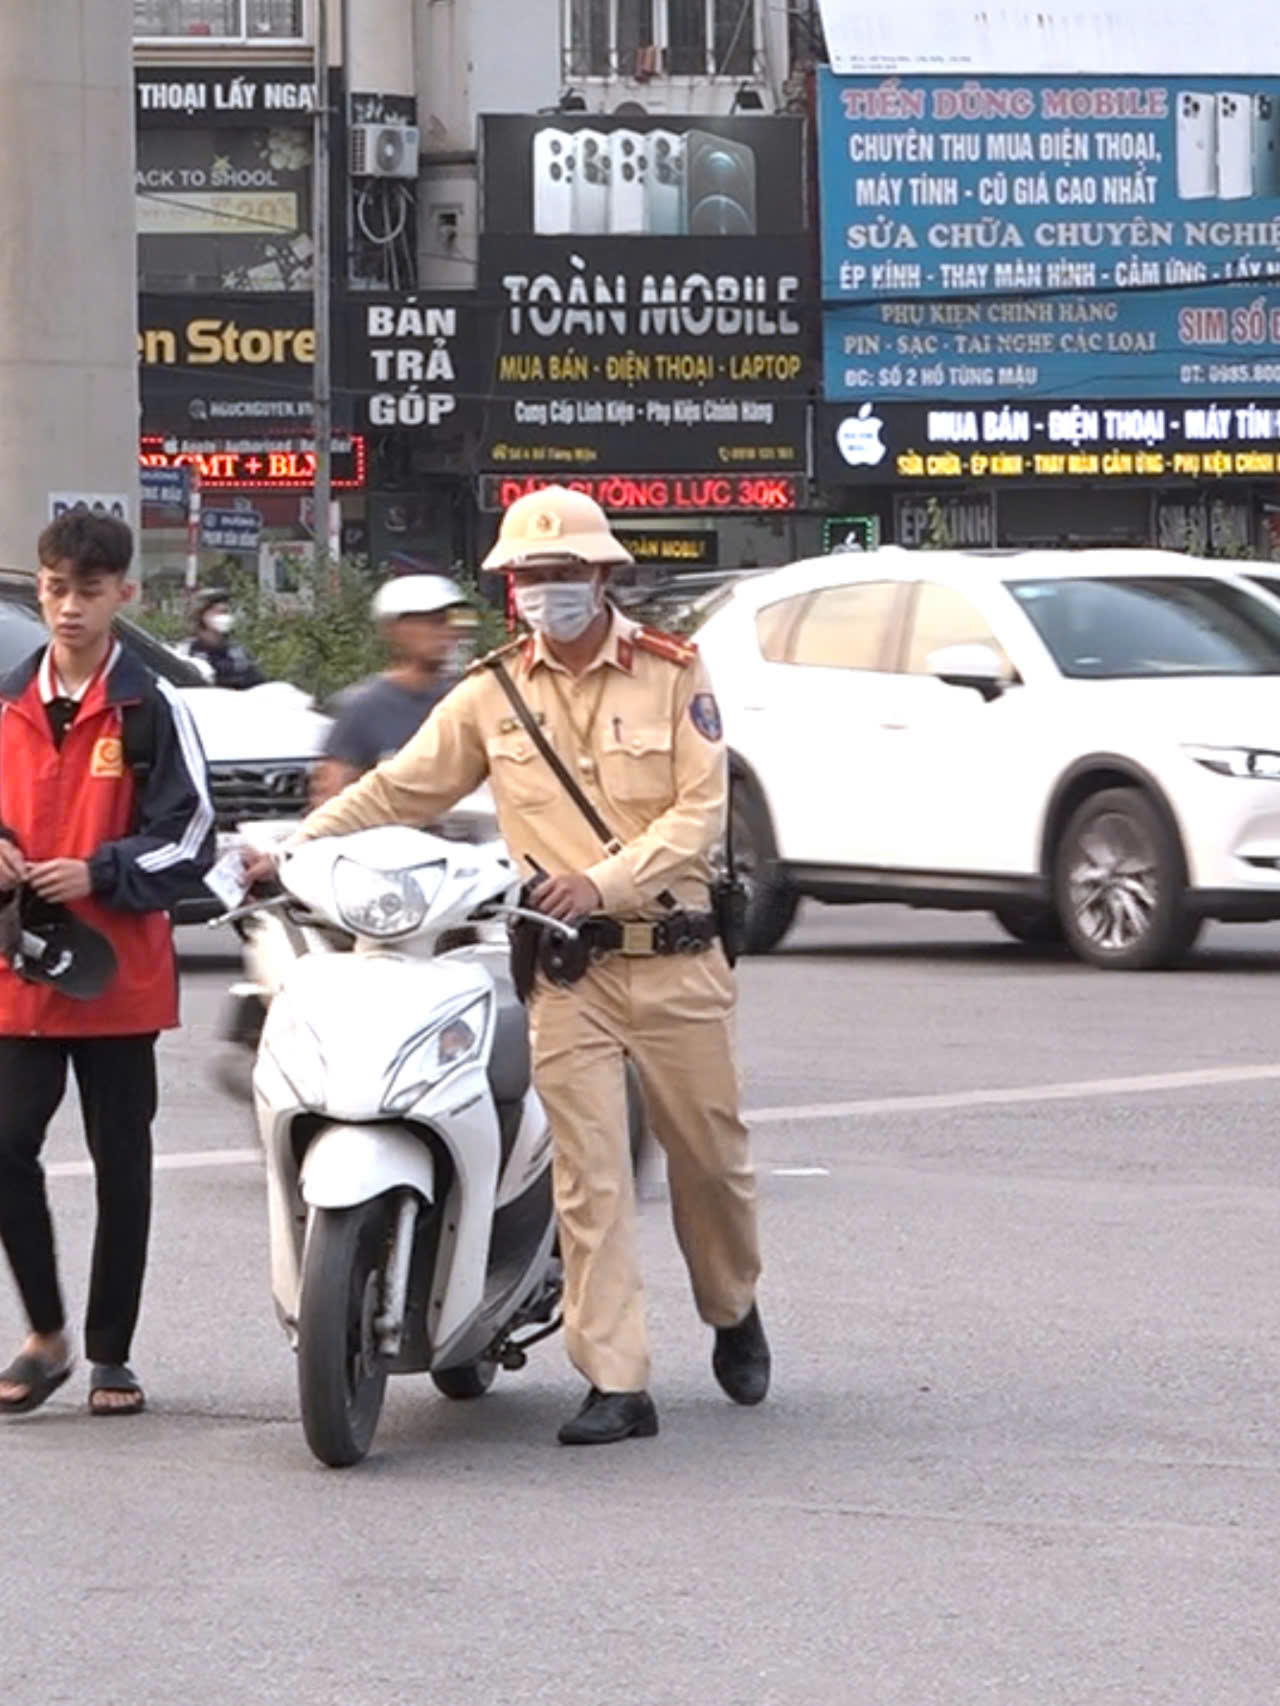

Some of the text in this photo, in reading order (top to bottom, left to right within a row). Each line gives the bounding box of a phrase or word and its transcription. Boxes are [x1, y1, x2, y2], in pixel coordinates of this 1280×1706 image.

[138, 75, 319, 115] THOẠI LẤY NGA
[841, 75, 924, 119] TIẾN
[1041, 87, 1168, 119] MOBILE
[849, 127, 934, 162] CHUYÊN
[939, 133, 980, 162] THU
[986, 133, 1034, 161] MUA
[1039, 128, 1088, 167] ĐIỆN
[181, 170, 206, 186] TO
[855, 171, 903, 206] MÁY
[908, 171, 959, 206] TÍNH
[1013, 171, 1050, 205] GIÁ
[1055, 176, 1097, 205] CAO
[1103, 165, 1158, 205] NHẤT
[847, 214, 918, 249] SỬA
[927, 216, 1024, 248] CHỮA
[1034, 215, 1173, 248] CHUYÊN
[839, 260, 867, 290] ÉP
[939, 263, 989, 289] THAY
[1114, 254, 1160, 287] CẢM
[502, 254, 800, 335] TOÀN MOBILE
[367, 296, 457, 336] BÁN
[1179, 307, 1228, 344] SIM
[1232, 296, 1266, 344] SỐ
[186, 318, 316, 364] Store
[370, 337, 456, 381] TRẢ
[844, 336, 880, 354] PIN
[897, 335, 939, 359] SẠC
[955, 335, 992, 354] TAI
[997, 333, 1055, 353] NGHE
[500, 348, 801, 388] MUA BÁN ĐIỆN THOẠI LAPTOP
[878, 362, 902, 386] SỐ
[906, 368, 917, 385] 2
[369, 385, 456, 425] GÓP
[928, 411, 978, 441] MUA
[983, 404, 1030, 441] BÁN
[1048, 404, 1099, 446] ĐIỆN
[1103, 410, 1165, 446] THOẠI
[1184, 402, 1231, 439] MÁY
